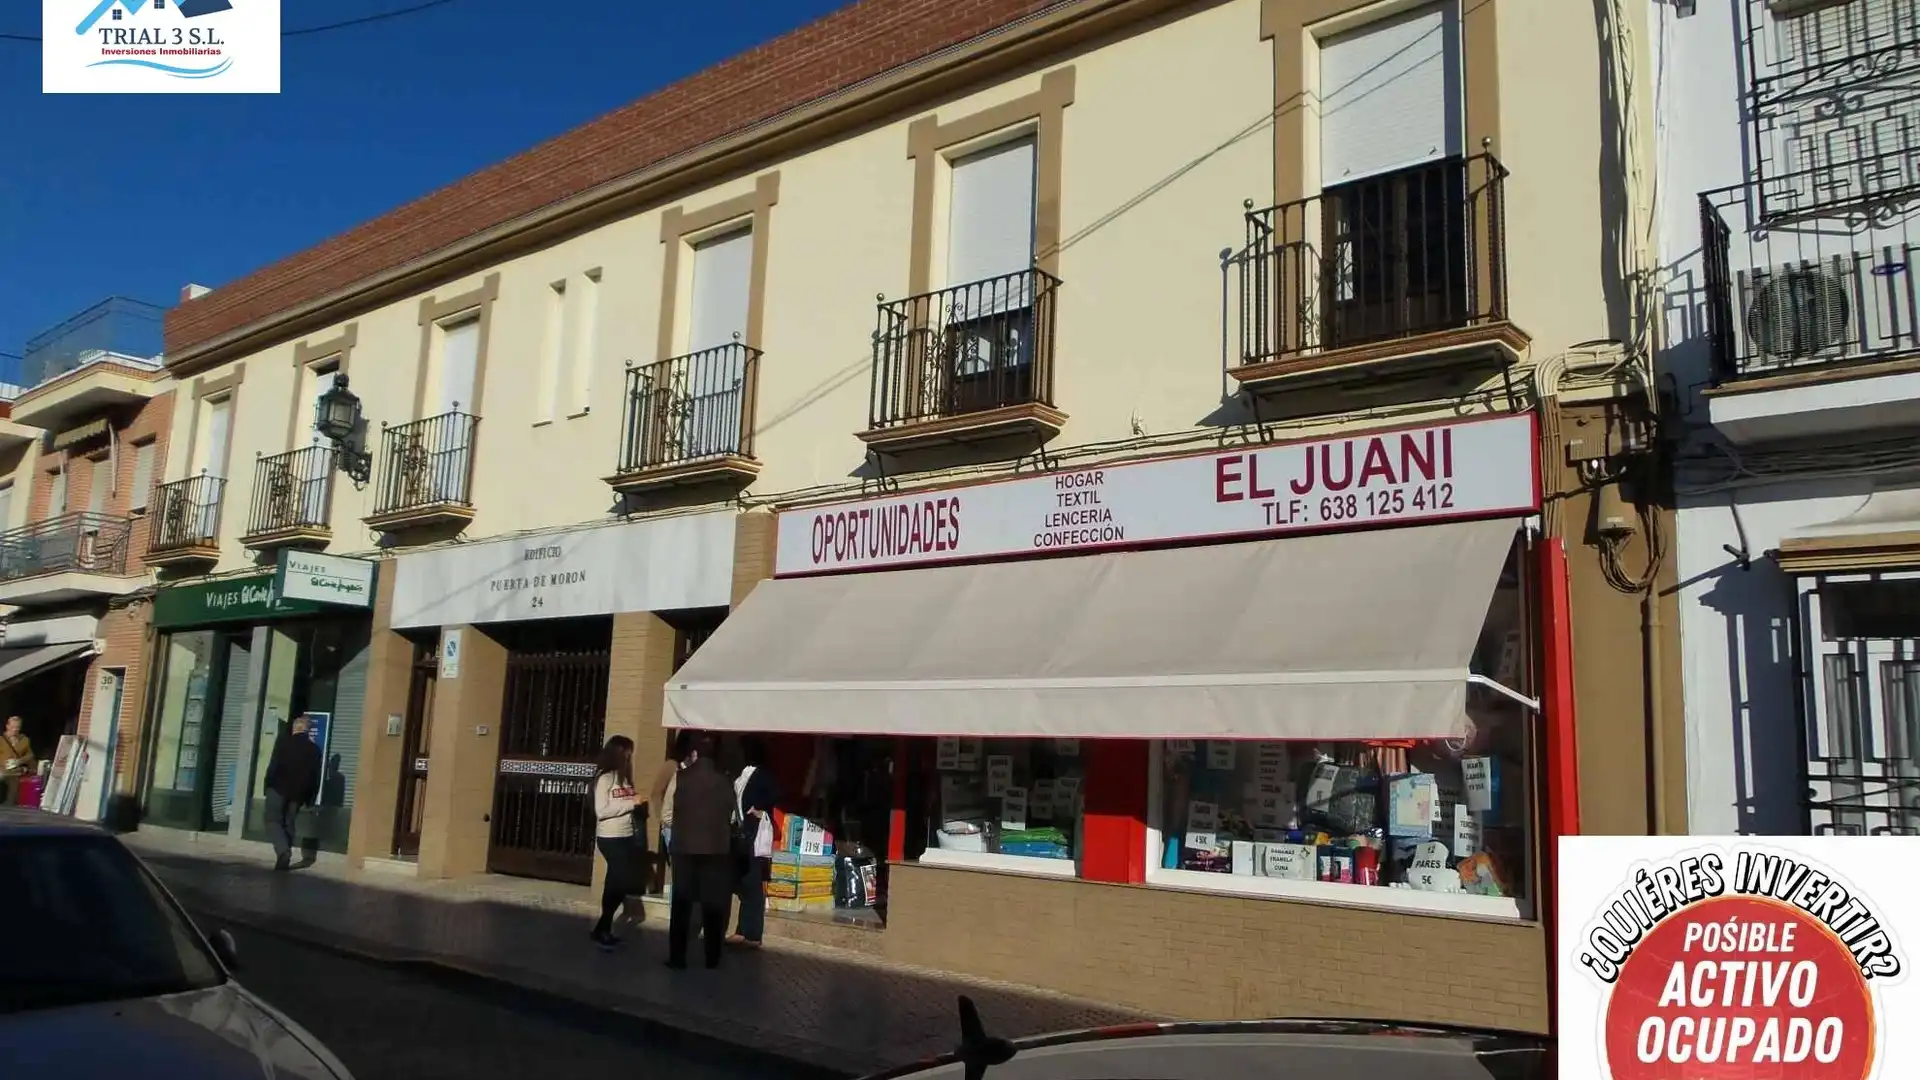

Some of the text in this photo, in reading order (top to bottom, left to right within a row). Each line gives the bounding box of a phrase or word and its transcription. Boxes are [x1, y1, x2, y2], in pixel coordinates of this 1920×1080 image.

[1216, 428, 1453, 503] EL JUANI
[1055, 471, 1104, 490] HOGAR
[1056, 490, 1102, 508] TEXTIL
[1262, 483, 1454, 526] TLF: 638 125 412
[1044, 508, 1113, 528] LENCERIA
[811, 496, 961, 565] OPORTUNIDADES
[1033, 523, 1125, 548] CONFECCIÓN
[524, 546, 561, 560] EDIFICIO
[288, 560, 326, 574] VIAJES
[490, 578, 529, 592] PUERTA
[533, 575, 547, 588] DE
[206, 591, 238, 609] VIAJES
[531, 596, 544, 608] 24
[101, 675, 113, 685] 30
[1415, 860, 1441, 869] PARES
[1421, 875, 1432, 885] 5€
